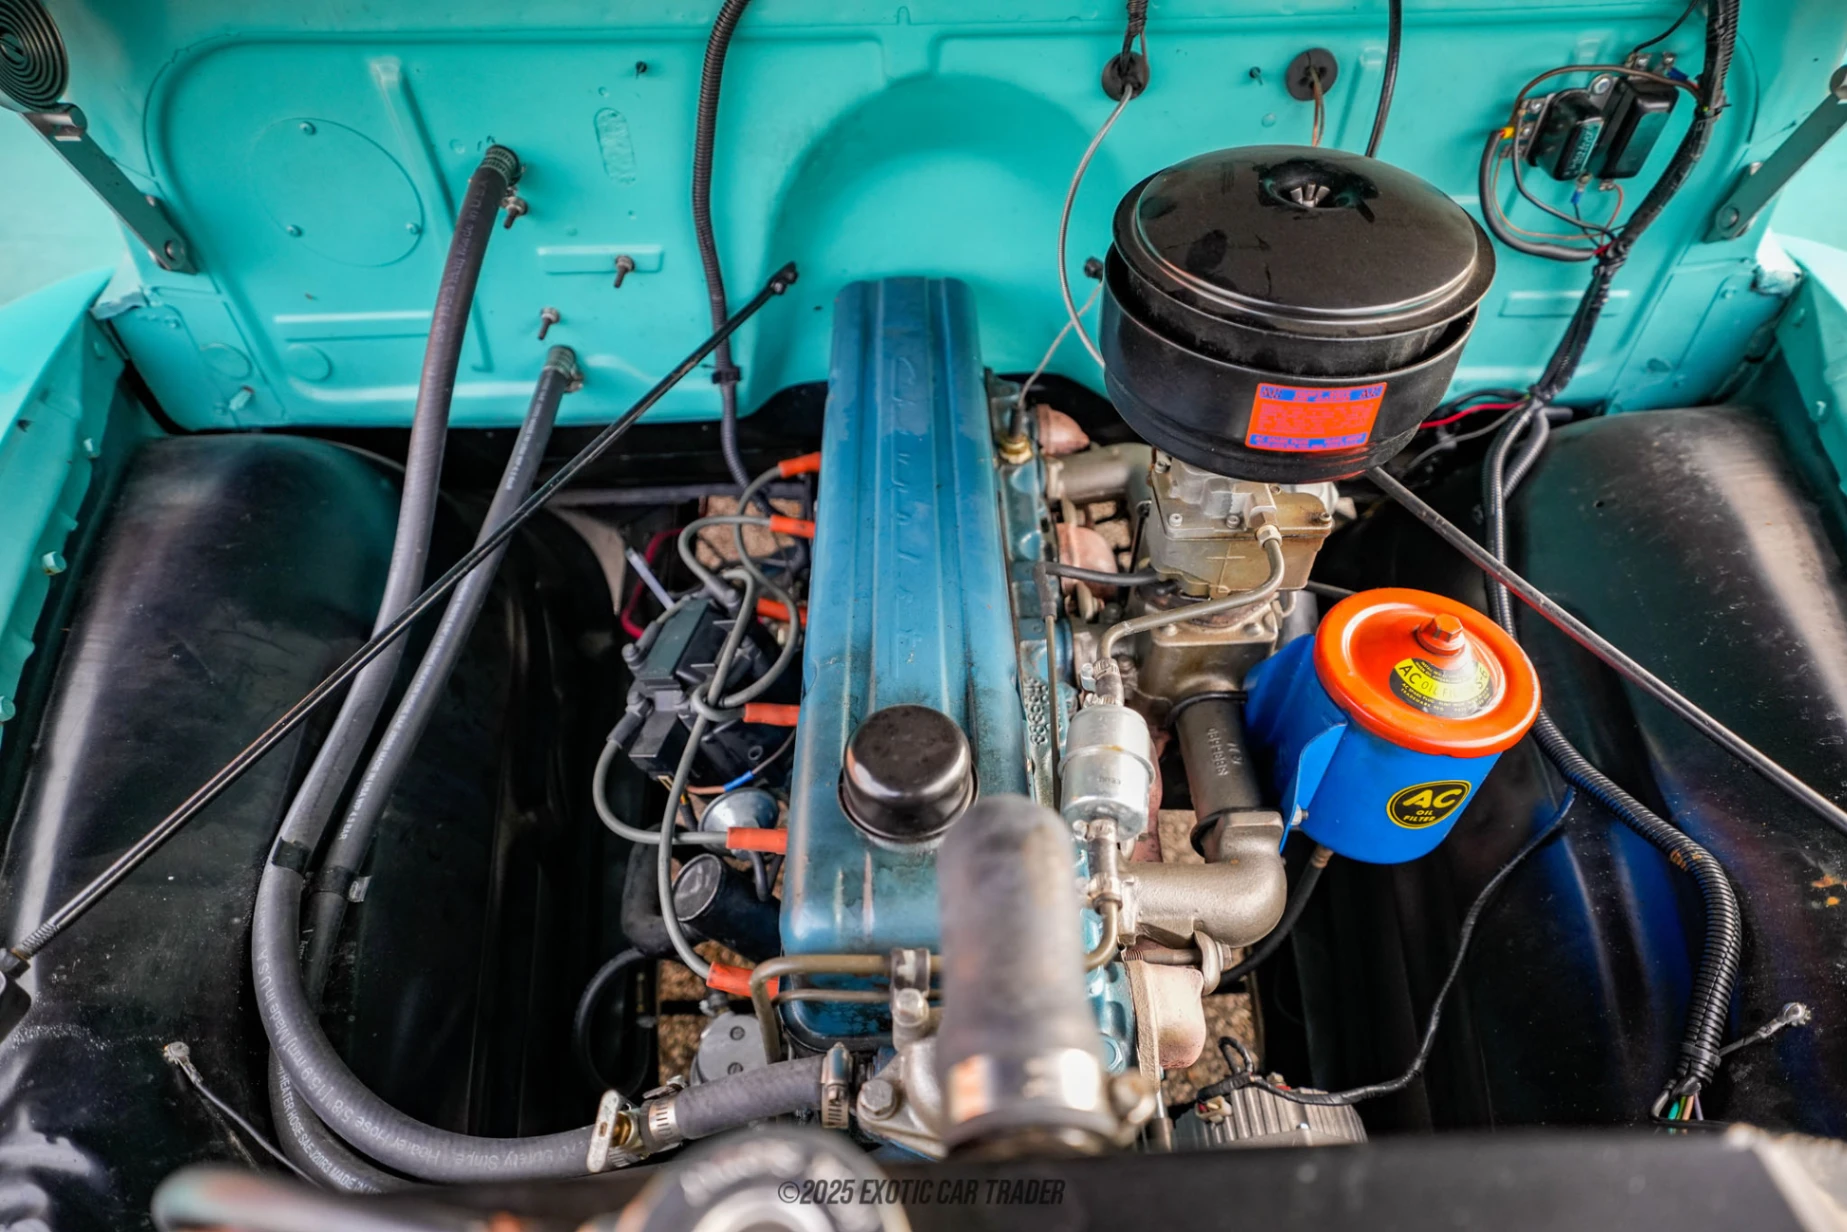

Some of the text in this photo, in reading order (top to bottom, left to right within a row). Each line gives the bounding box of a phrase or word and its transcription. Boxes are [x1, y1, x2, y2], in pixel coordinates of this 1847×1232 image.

[1399, 664, 1422, 685] AC
[1421, 680, 1438, 696] OIL
[1402, 789, 1463, 809] AC
[1403, 815, 1436, 823] FILTER
[268, 1002, 291, 1044] Made
[279, 1072, 296, 1113] HEATER
[286, 1110, 305, 1137] HOSE
[354, 1115, 391, 1147] Hose
[297, 1133, 316, 1154] SAE
[328, 1166, 360, 1190] MADE
